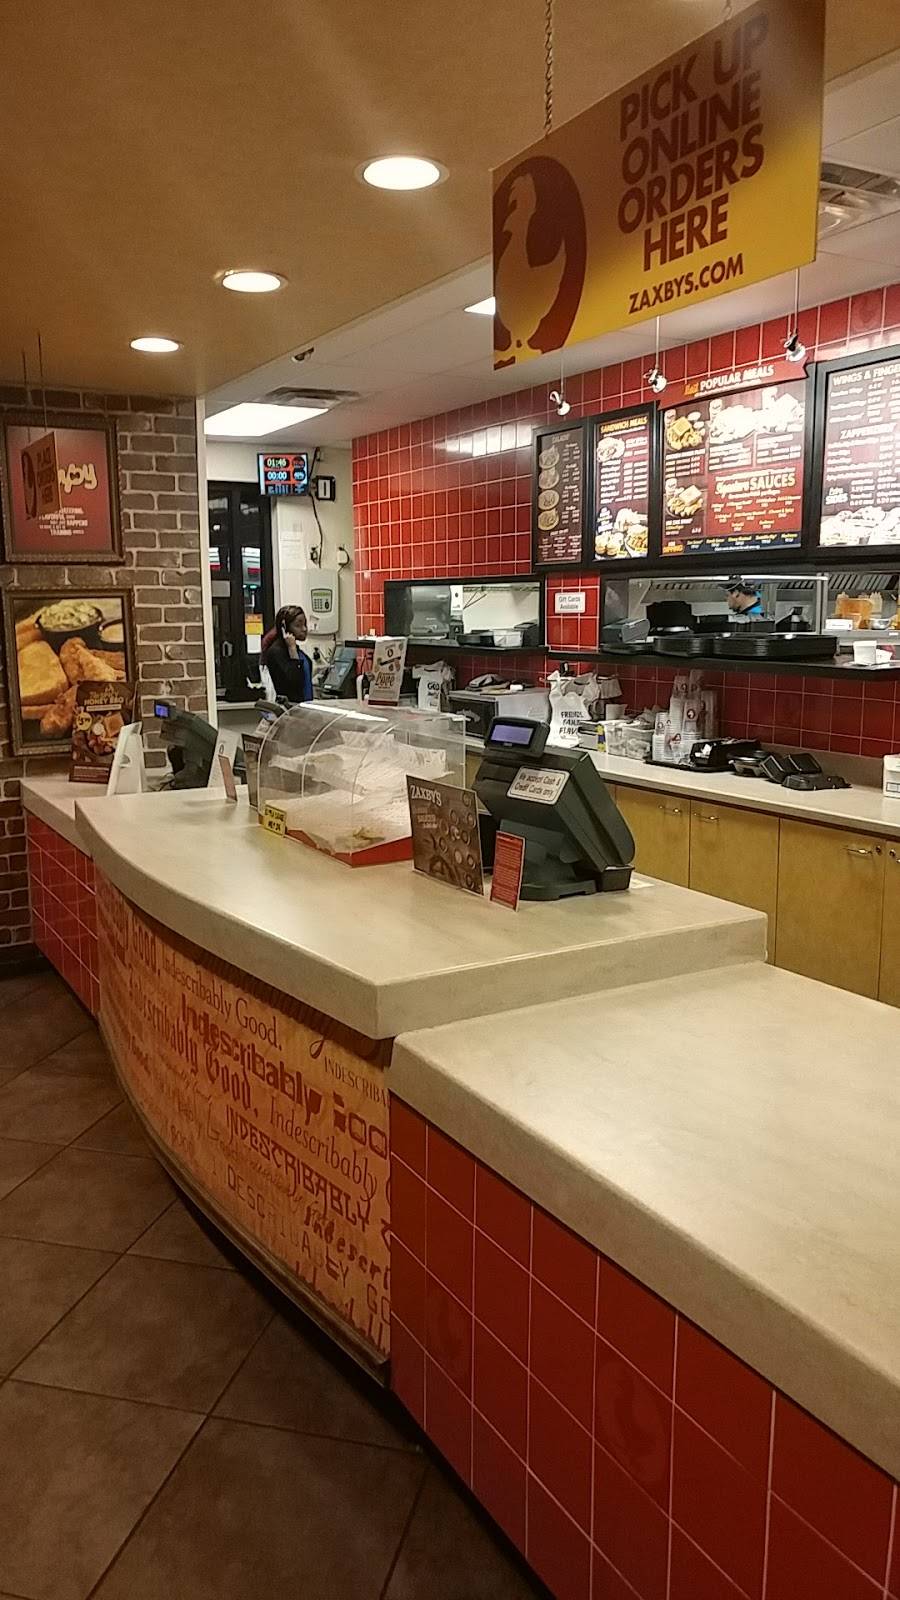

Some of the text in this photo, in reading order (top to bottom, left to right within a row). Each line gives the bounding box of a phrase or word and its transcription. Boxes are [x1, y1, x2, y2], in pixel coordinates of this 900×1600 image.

[620, 11, 769, 142] PICK UP
[621, 70, 761, 186] ONLINE
[617, 123, 765, 234] ORDERS
[643, 192, 729, 272] HERE
[628, 253, 744, 314] ZAXBYS.COM
[700, 371, 742, 391] POPULAR
[742, 364, 775, 381] MEALS
[833, 372, 863, 386] WINGS
[600, 420, 629, 433] SANDWICH
[629, 416, 648, 428] MEALS
[750, 473, 796, 491] SAUCES
[410, 784, 442, 807] ZAXBY'S
[324, 1056, 389, 1108] INDESCRIBA
[225, 1104, 371, 1233] INDESCRIBABLY
[269, 1096, 377, 1201] Indescribably
